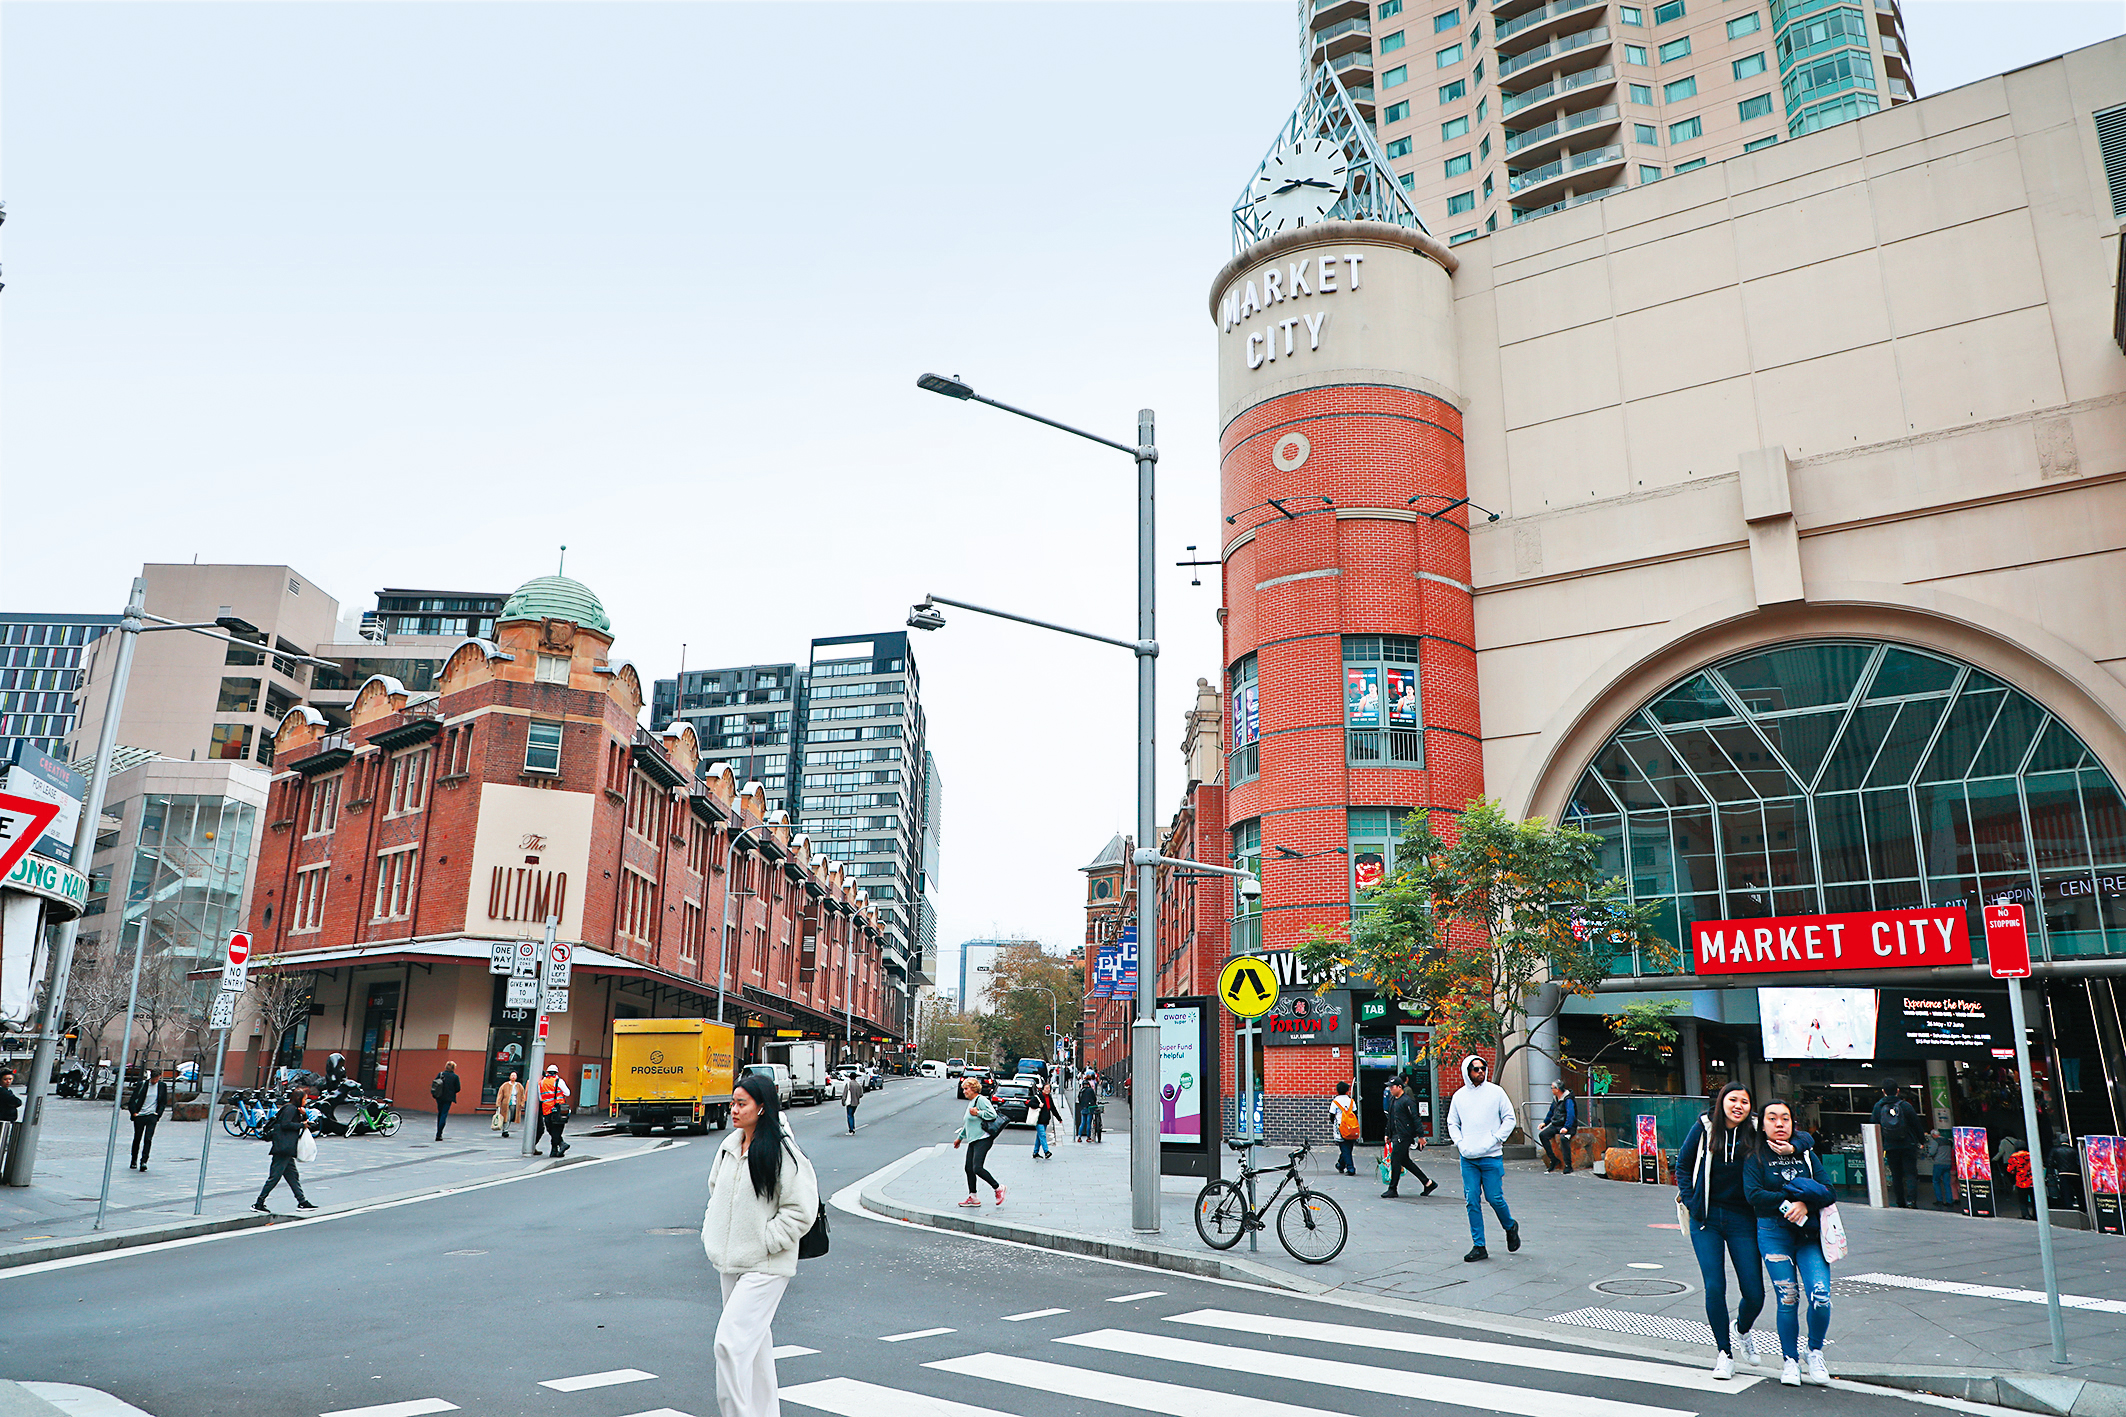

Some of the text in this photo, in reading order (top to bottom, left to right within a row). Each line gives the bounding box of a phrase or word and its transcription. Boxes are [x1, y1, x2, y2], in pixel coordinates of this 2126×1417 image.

[1223, 254, 1364, 333] MARKET
[1246, 311, 1325, 369] CITY
[40, 757, 70, 782] CREATIVE
[518, 833, 548, 852] The
[488, 866, 567, 924] ULTIMO
[1997, 909, 2009, 917] NO
[1989, 919, 2020, 928] STOPPING
[1701, 917, 1955, 964] MARKET CITY
[495, 946, 511, 954] ONE
[229, 967, 241, 977] NO
[223, 978, 243, 988] ENTRY
[1364, 1004, 1385, 1014] TAB
[1903, 997, 1942, 1010] Experience
[1957, 1000, 1982, 1013] Magic
[502, 1009, 528, 1019] nab
[1328, 1015, 1339, 1031] 8
[1177, 1043, 1193, 1051] Fund
[1164, 1052, 1184, 1060] helpful
[631, 1066, 684, 1074] PROSEGUR
